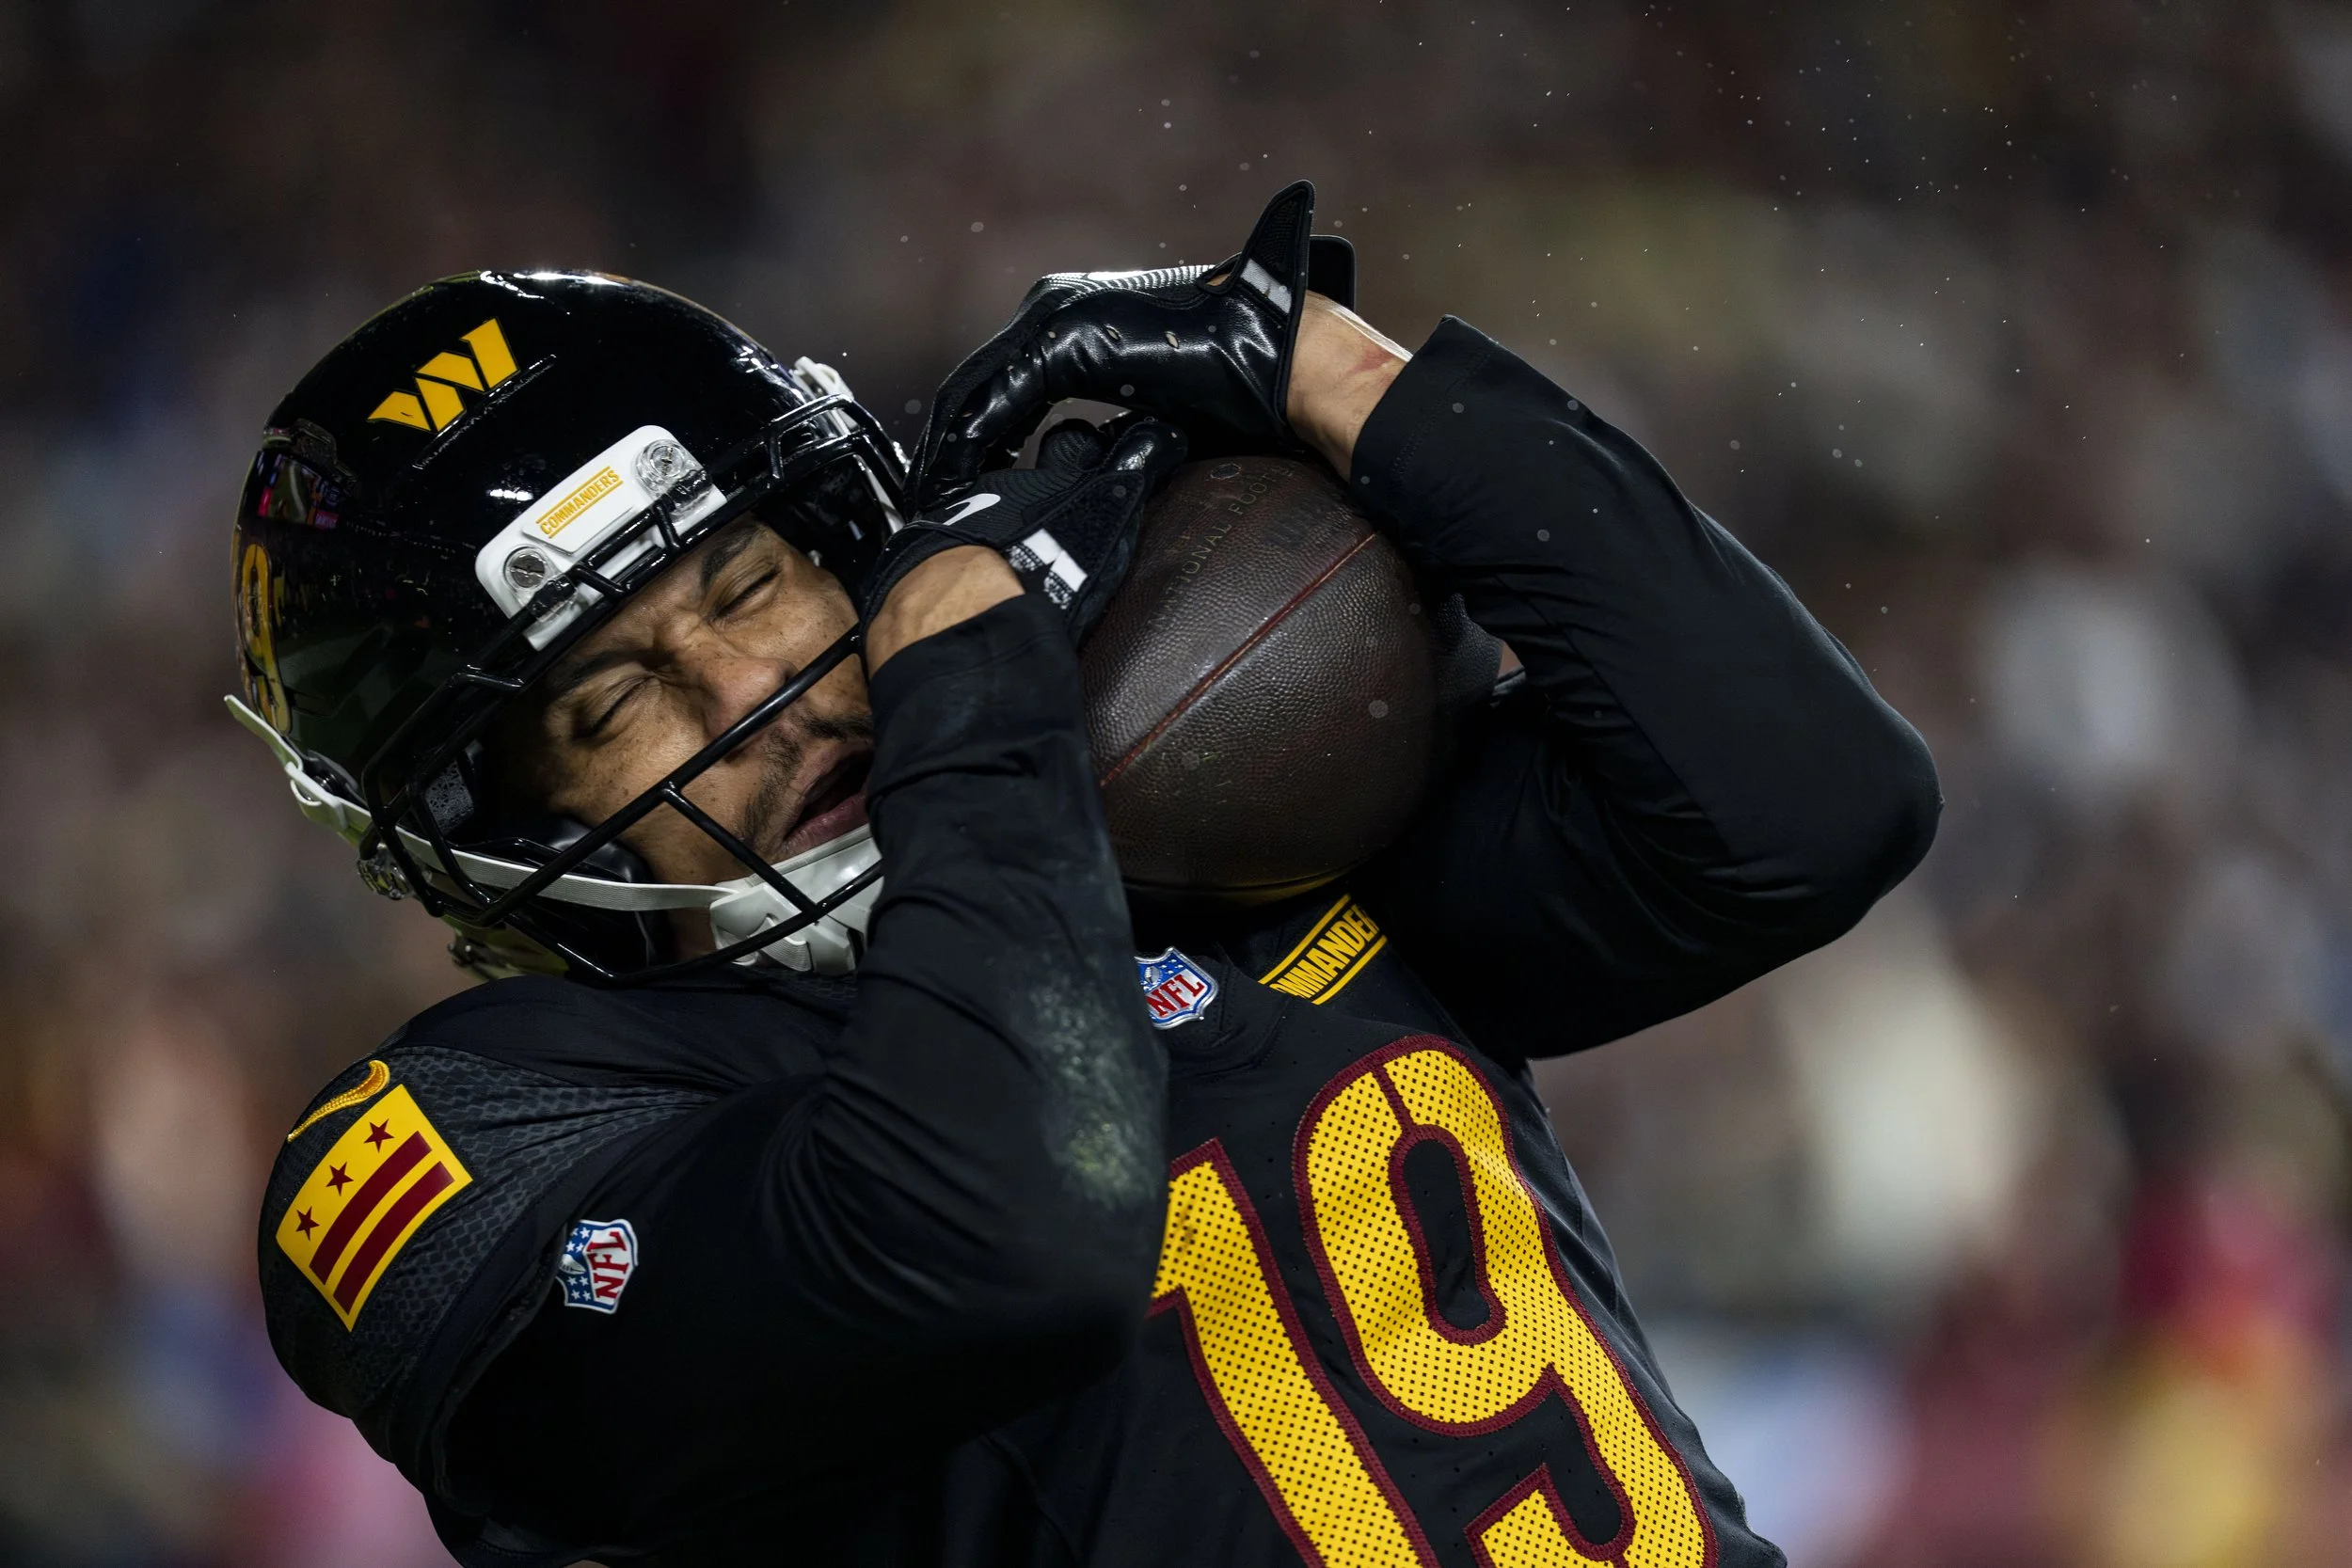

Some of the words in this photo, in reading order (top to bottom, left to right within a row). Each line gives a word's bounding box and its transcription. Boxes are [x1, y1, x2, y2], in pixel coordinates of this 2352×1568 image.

[539, 469, 620, 535] COMMANDERS
[1145, 974, 1205, 1018] NFL
[586, 1230, 629, 1299] NFL
[1147, 1036, 1720, 1568] 19
